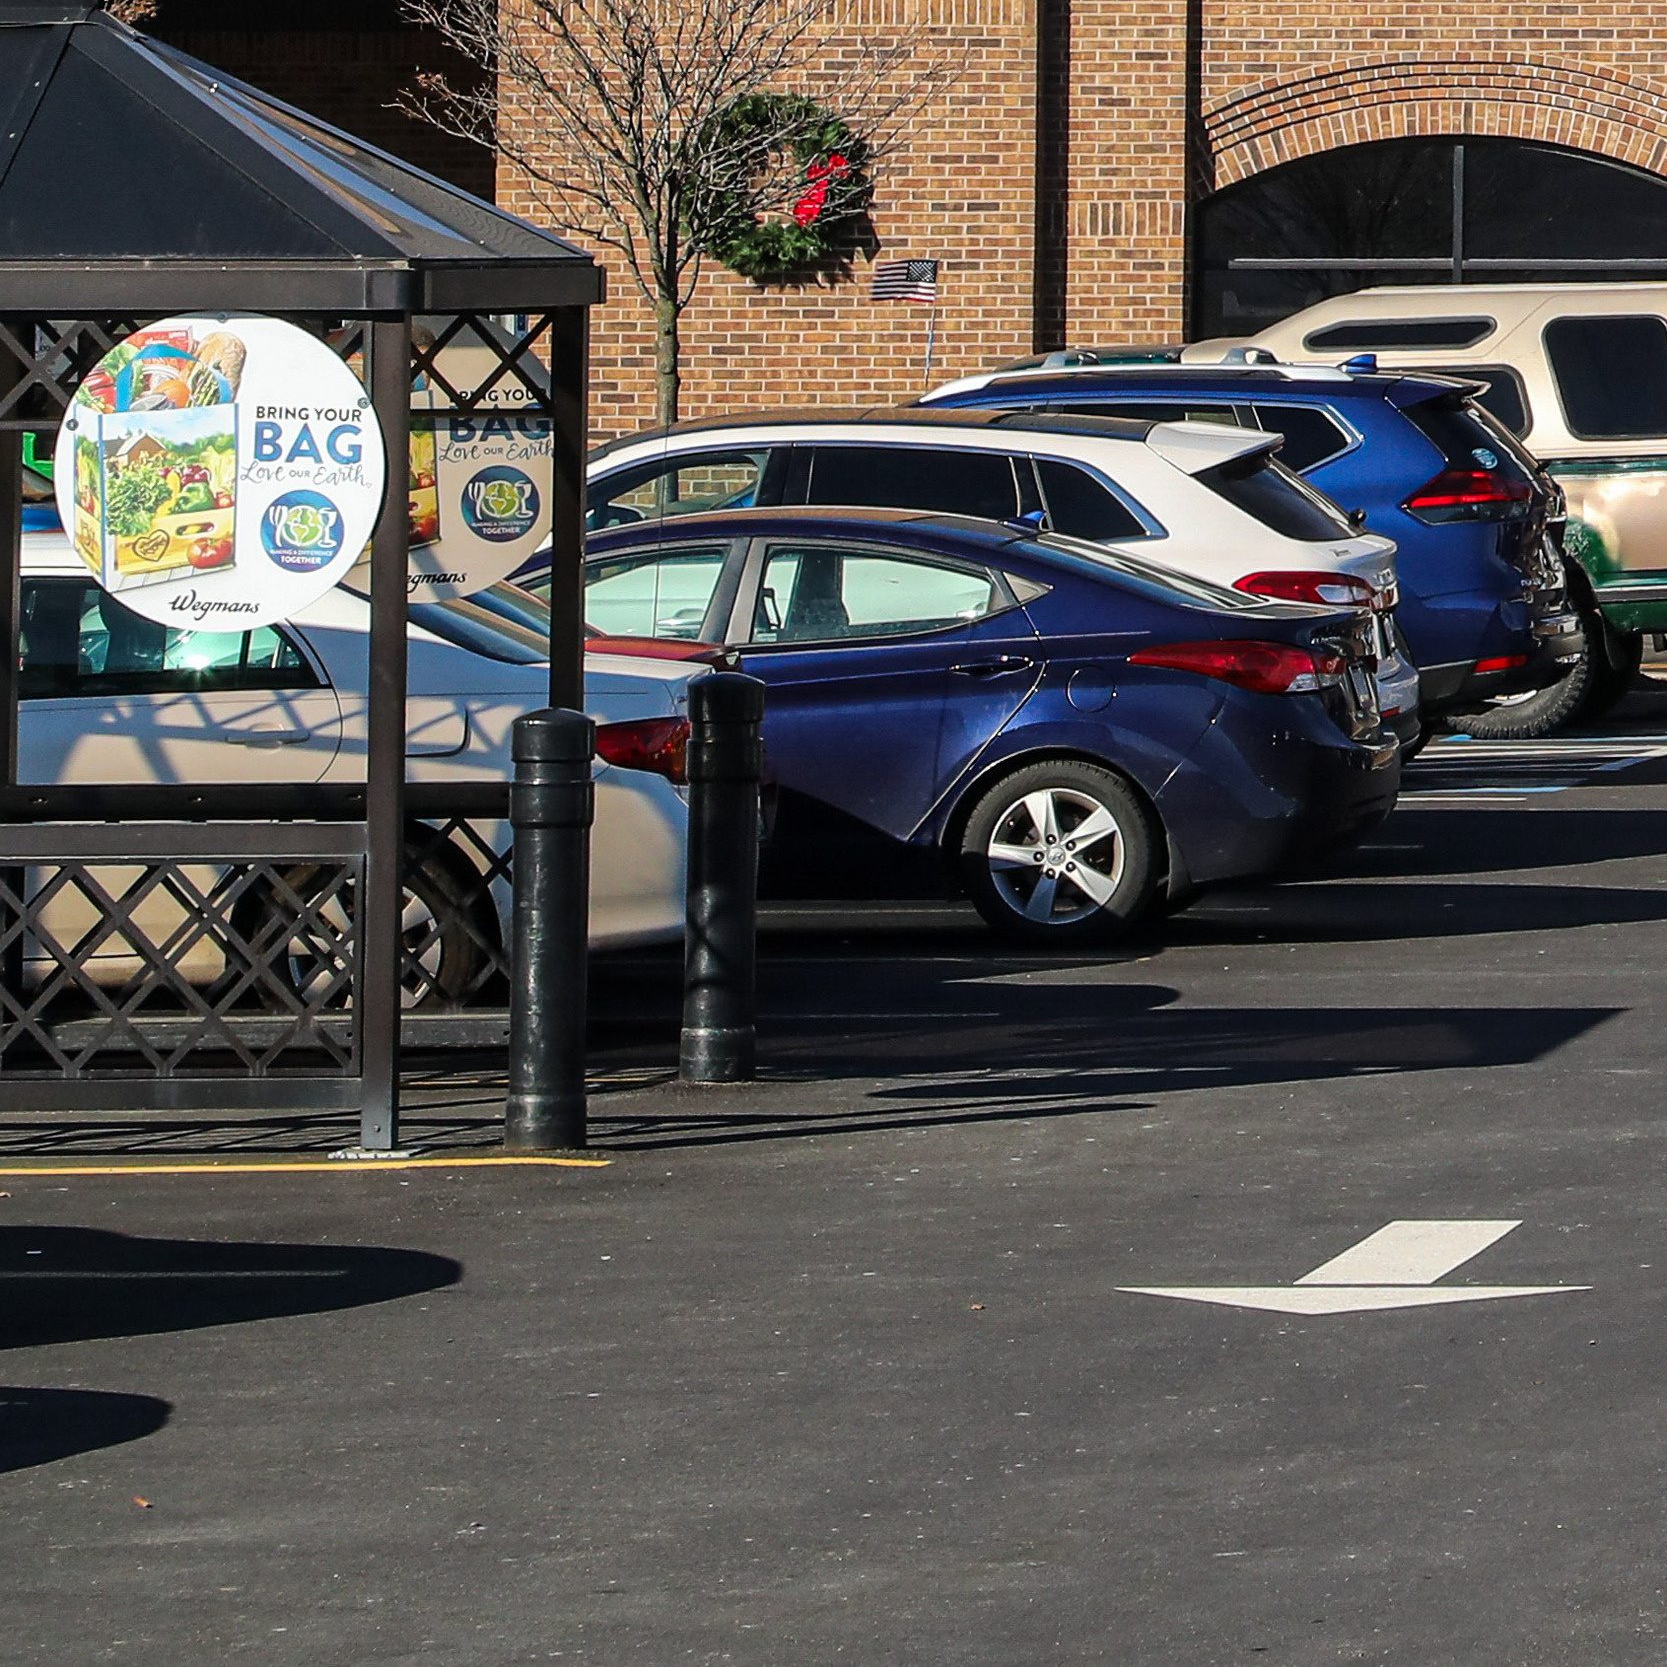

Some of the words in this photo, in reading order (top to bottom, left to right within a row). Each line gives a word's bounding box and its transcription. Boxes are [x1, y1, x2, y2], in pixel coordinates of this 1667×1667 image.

[256, 406, 310, 421] BRING
[314, 408, 362, 422] YOUR
[254, 421, 362, 465] BAG
[439, 442, 481, 463] Love
[484, 447, 503, 455] OUR
[240, 460, 285, 484] Love
[289, 470, 310, 478] OUR
[312, 461, 365, 486] Earth
[280, 556, 322, 565] TOGETHER
[168, 589, 260, 621] Wegmans
